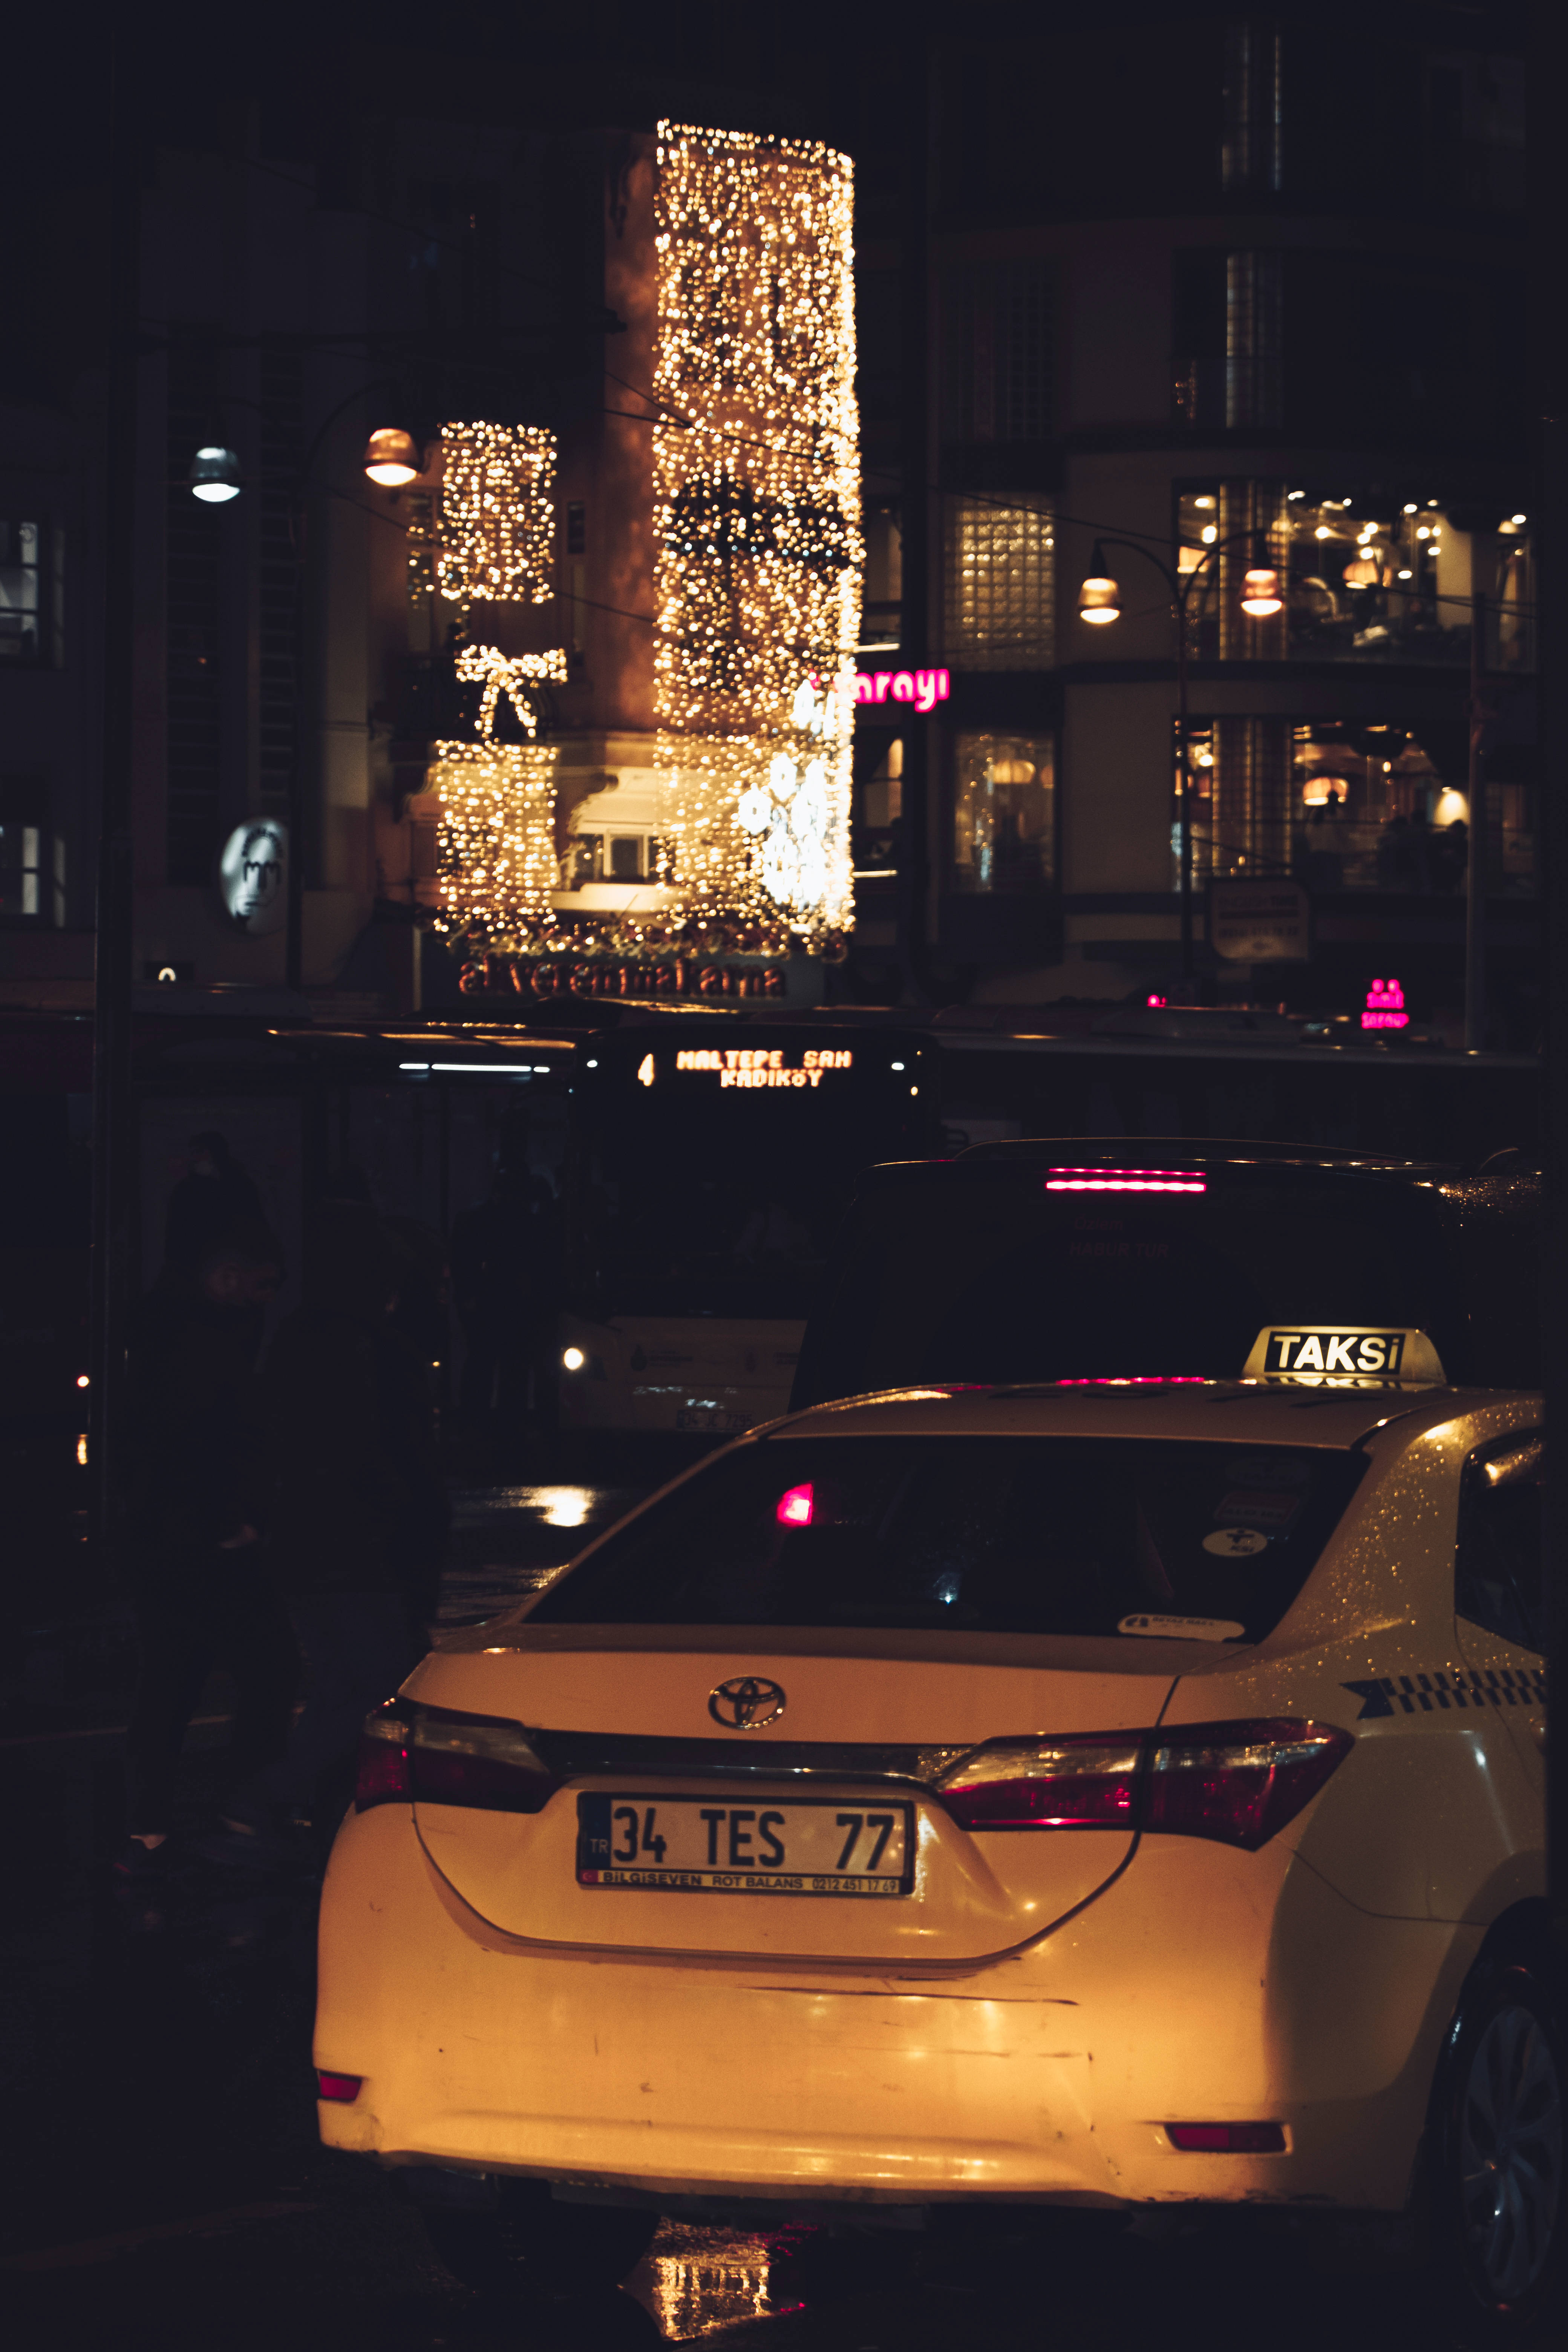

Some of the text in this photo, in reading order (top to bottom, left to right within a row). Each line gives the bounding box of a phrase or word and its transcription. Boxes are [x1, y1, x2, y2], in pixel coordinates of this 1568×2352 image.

[834, 668, 949, 713] arayı
[637, 1054, 654, 1086] 4
[676, 1050, 783, 1070] MALTEPE
[1134, 1242, 1170, 1259] TUR
[589, 1839, 609, 1853] TR
[613, 1807, 894, 1871] 34 TES 77
[712, 1876, 741, 1886] ROT
[746, 1877, 803, 1888] BALANS
[812, 1878, 840, 1890] 0212
[842, 1879, 862, 1891] 451
[868, 1879, 879, 1891] 17
